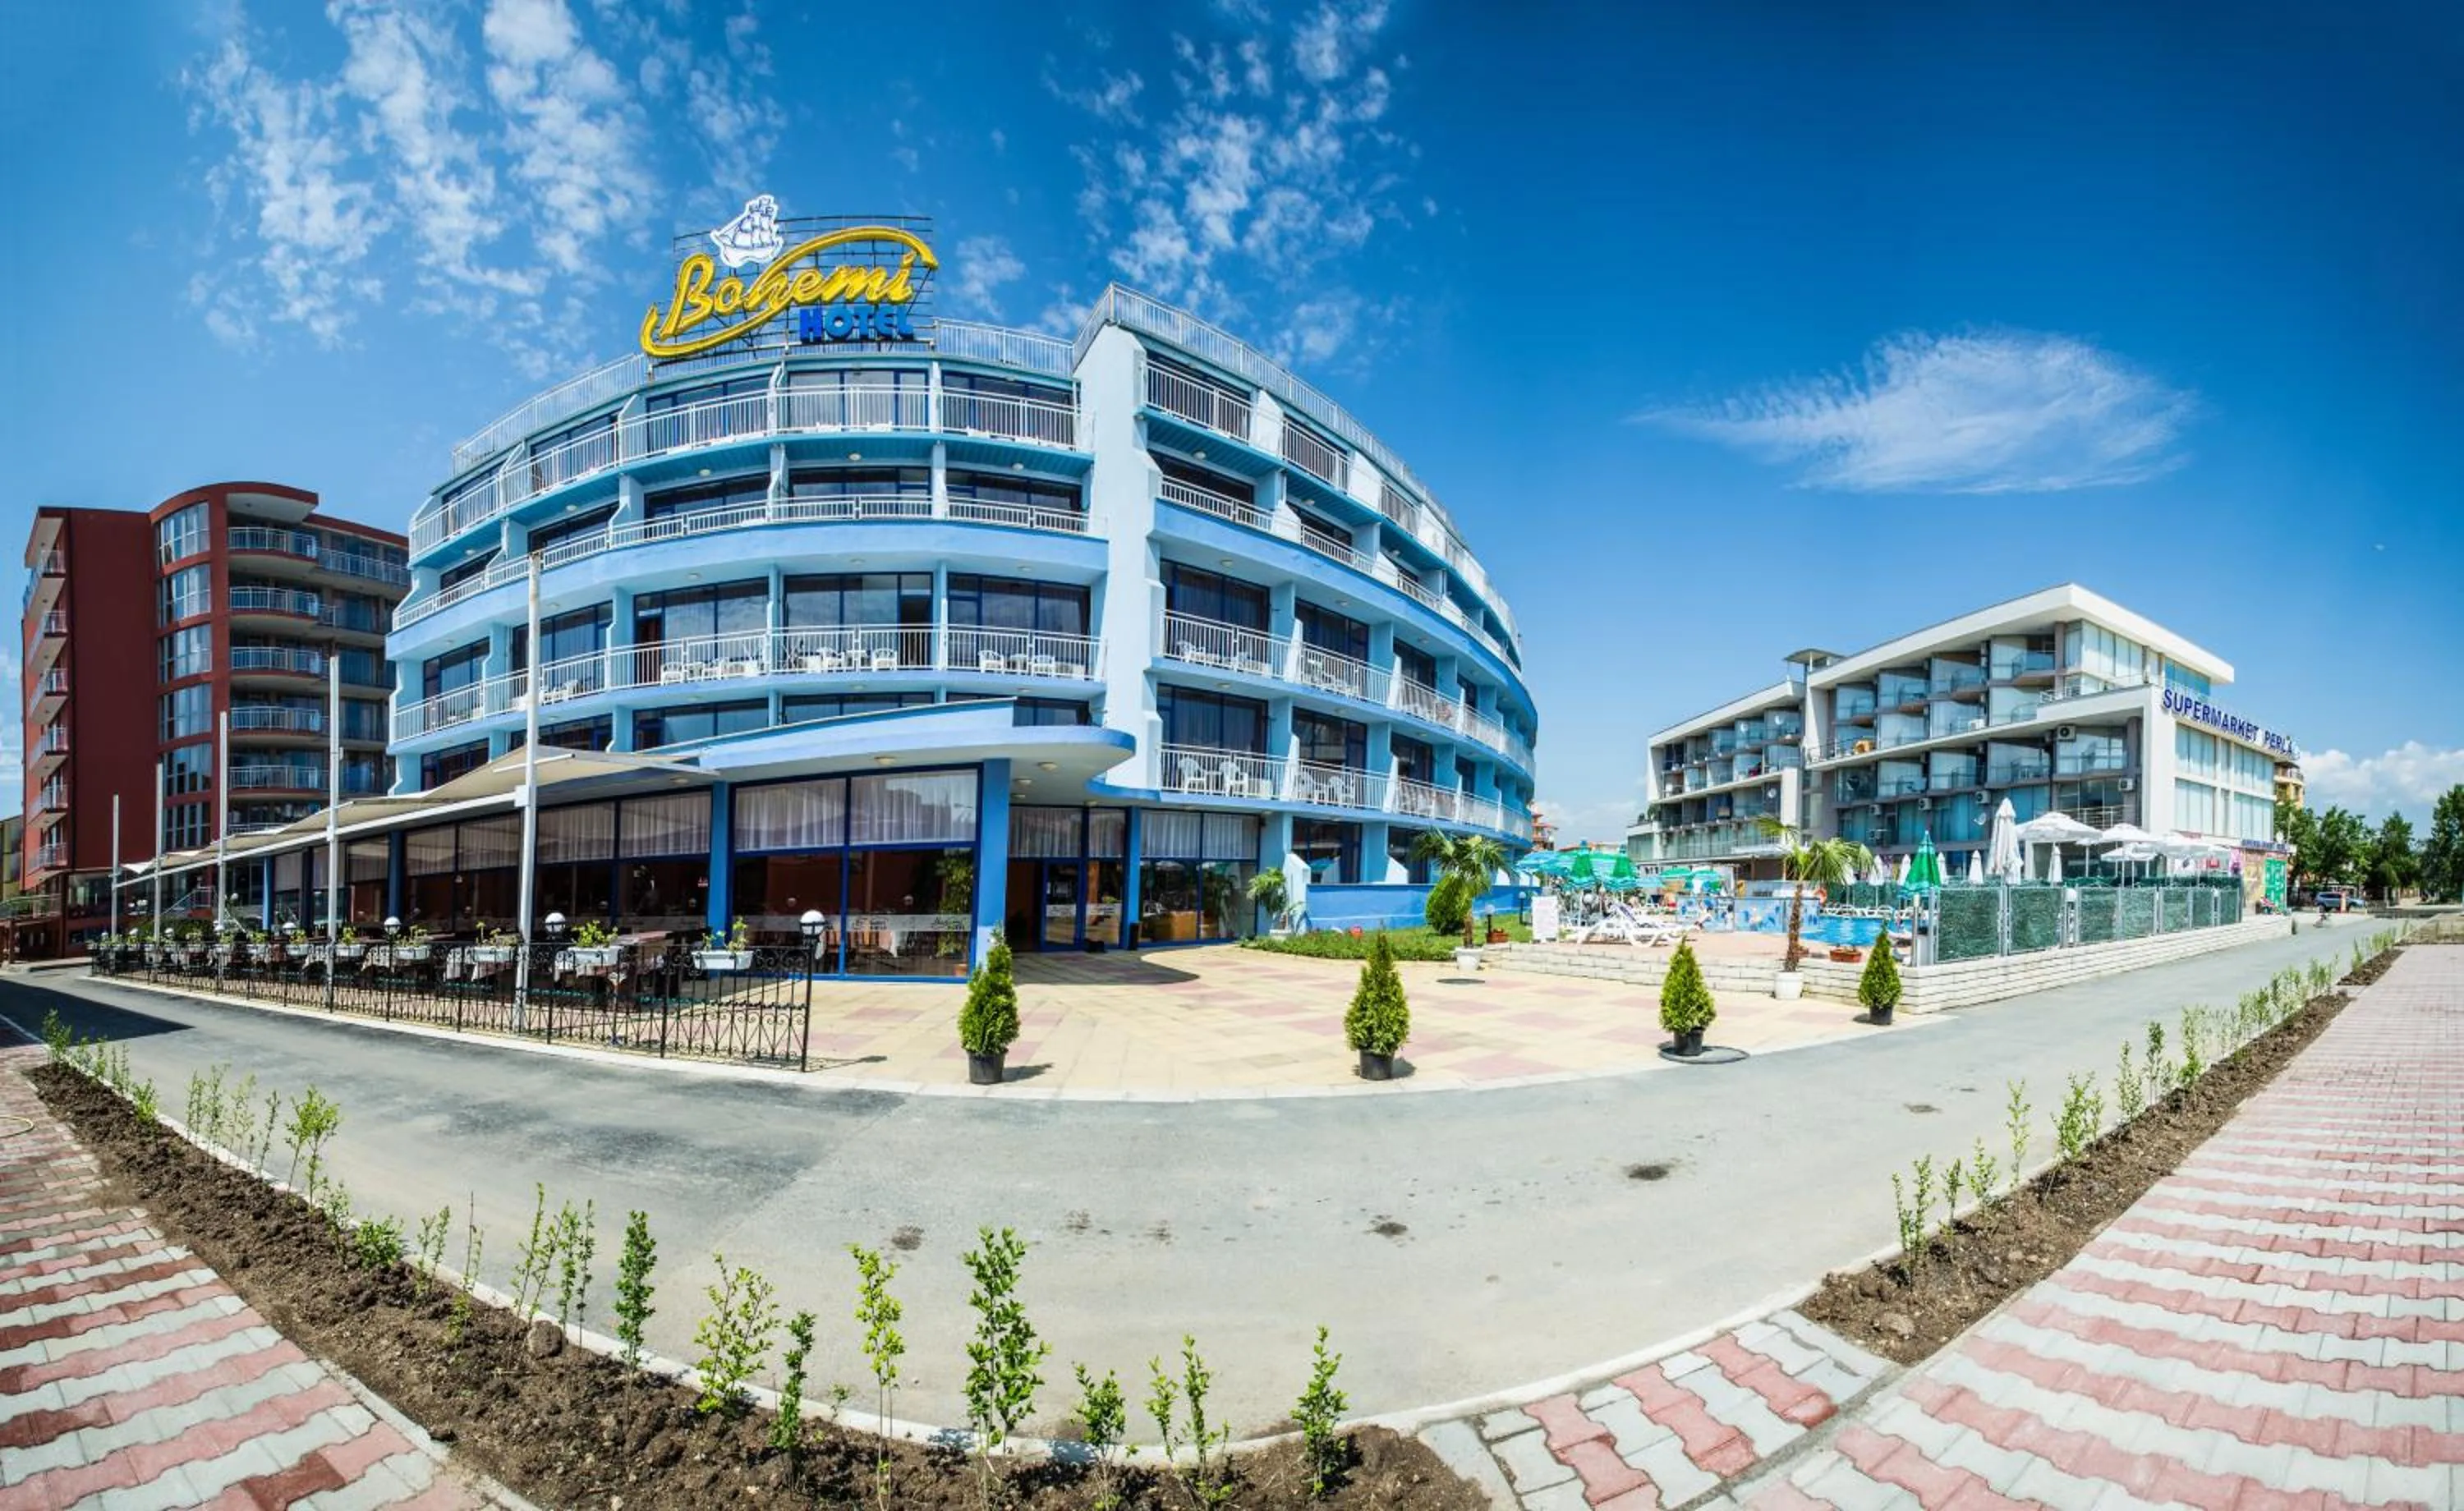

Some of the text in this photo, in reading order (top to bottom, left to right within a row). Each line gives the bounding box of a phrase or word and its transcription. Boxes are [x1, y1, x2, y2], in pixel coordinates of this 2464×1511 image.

[641, 226, 939, 356] Bohemi
[799, 305, 915, 342] HOTEL
[2163, 688, 2259, 742] SUPERMARKET
